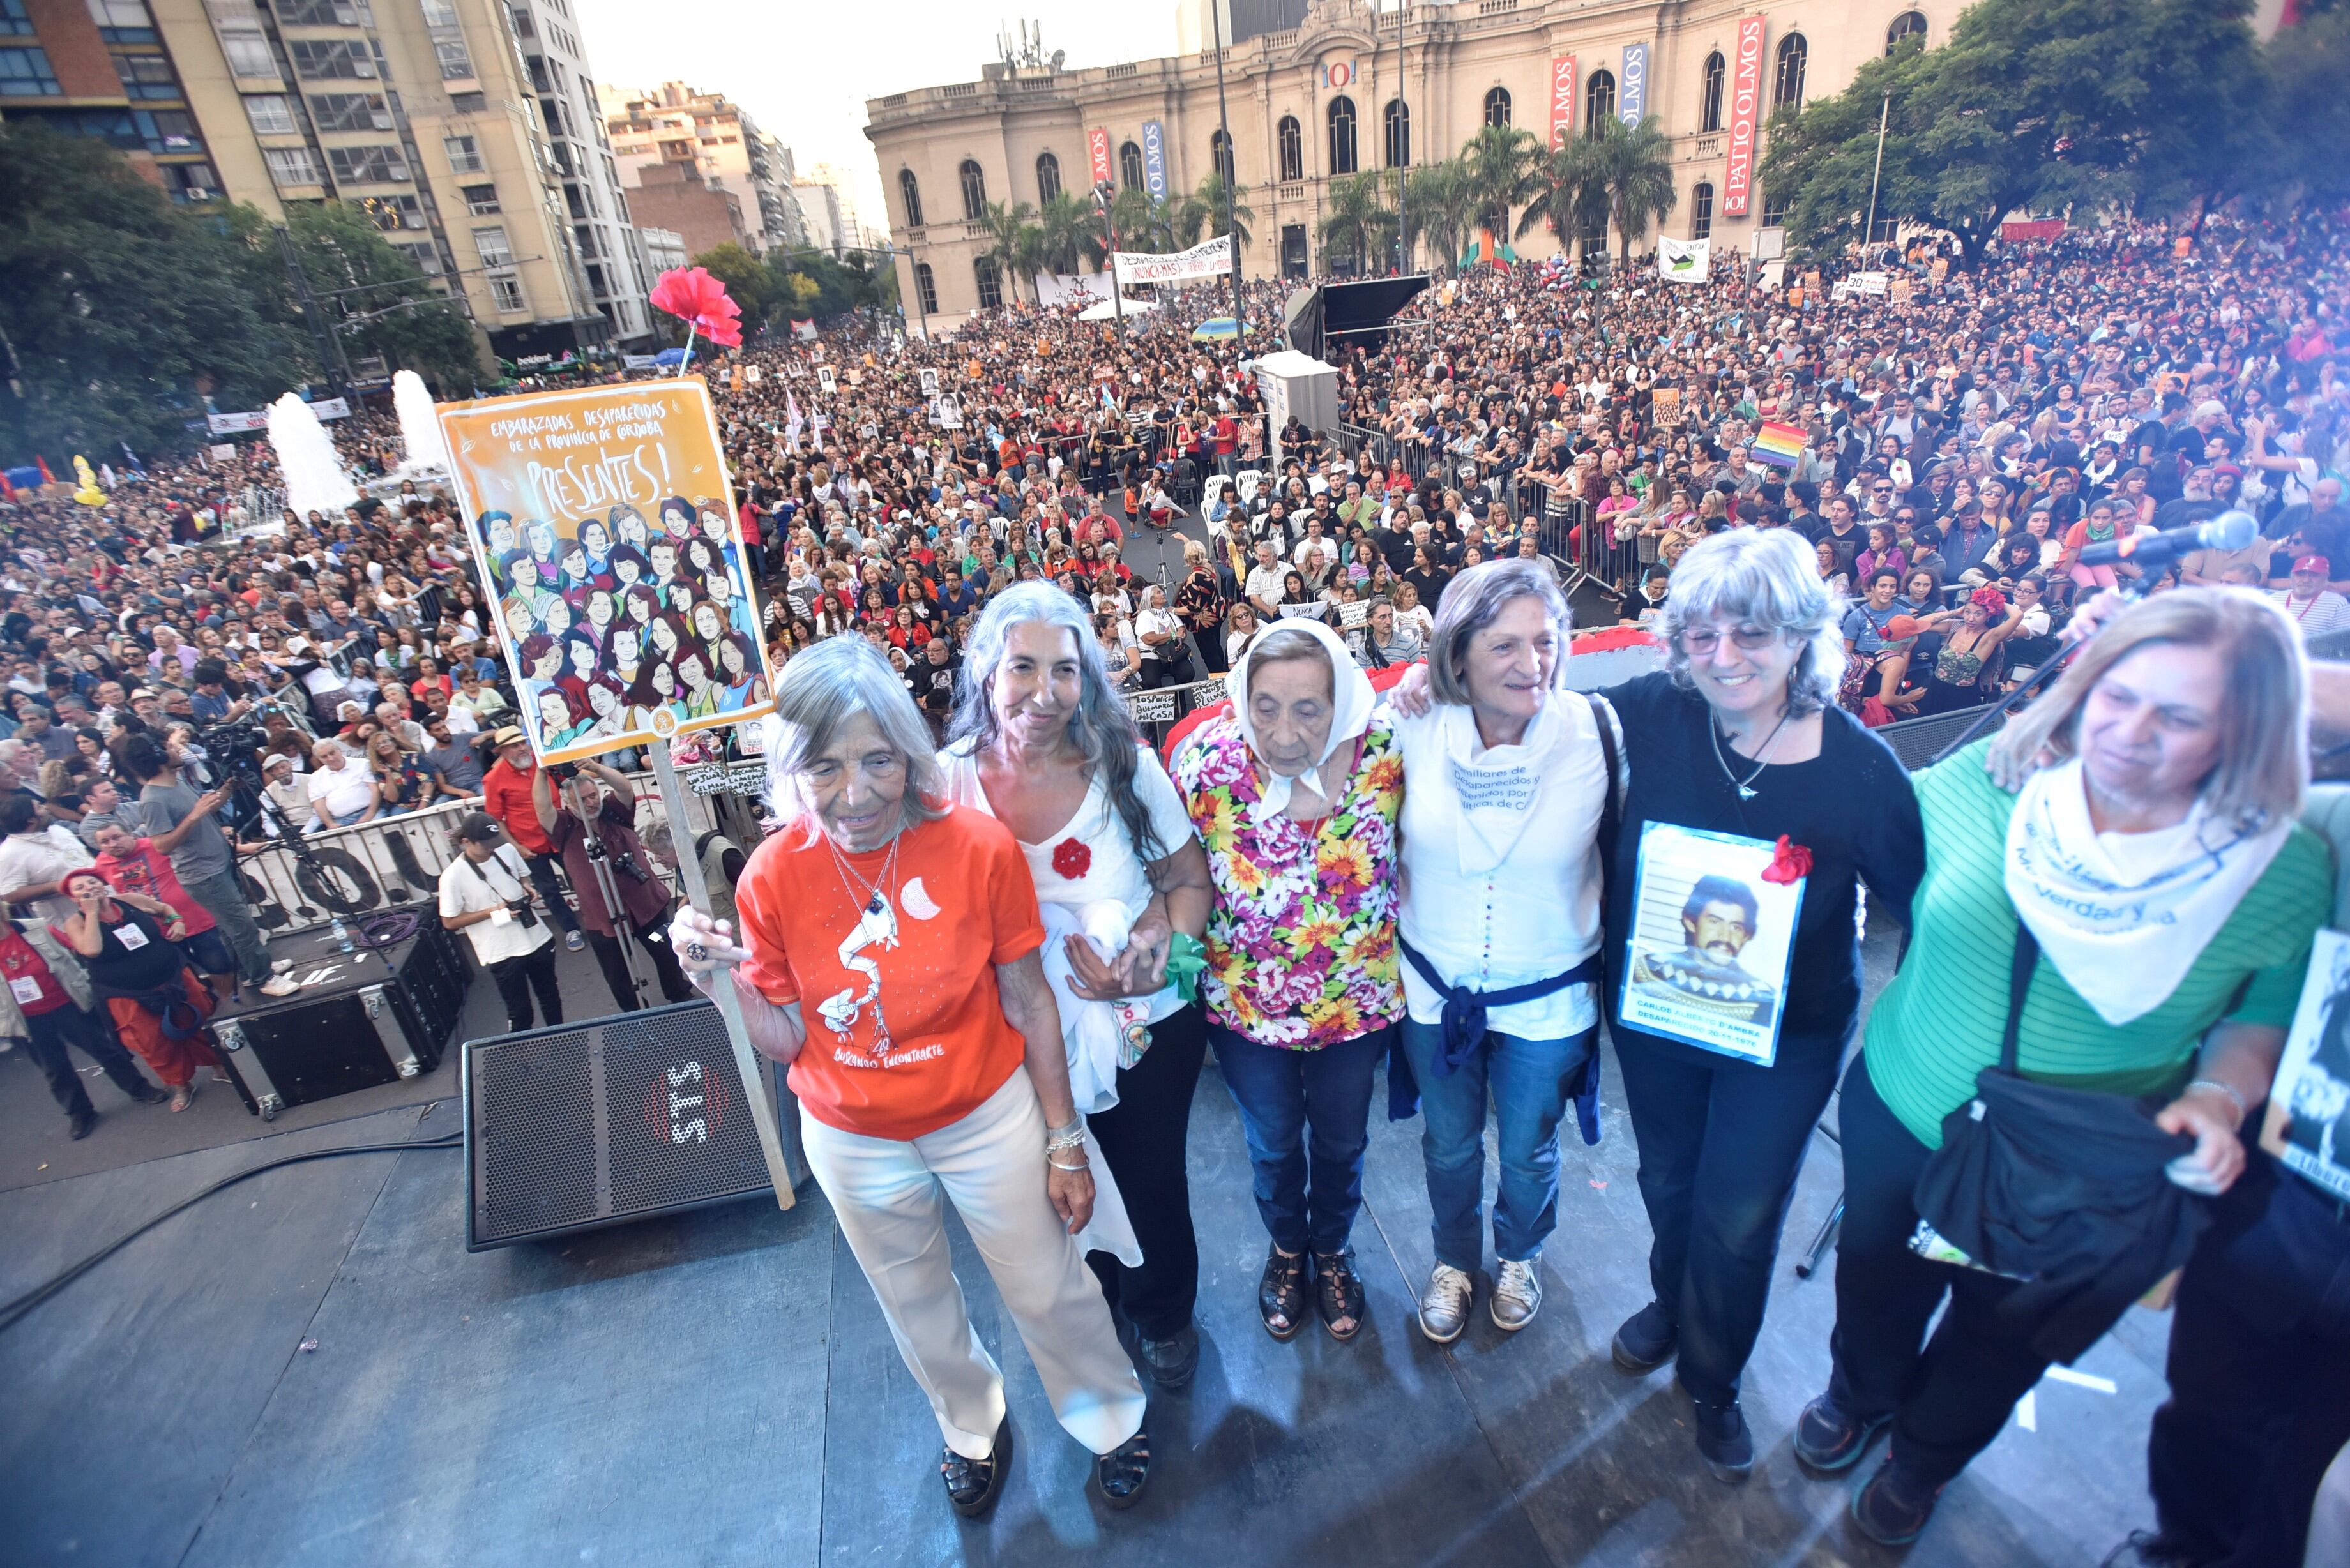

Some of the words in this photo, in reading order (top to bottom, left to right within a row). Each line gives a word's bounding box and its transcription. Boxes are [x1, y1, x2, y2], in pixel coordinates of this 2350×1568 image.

[1736, 20, 1760, 116] OLMOS
[1622, 47, 1643, 131] OLMOS
[1553, 61, 1572, 143] OLMOS
[1091, 132, 1109, 185] LMOS
[1144, 124, 1164, 192] OLMOS
[1729, 119, 1750, 192] PATIO
[1724, 195, 1745, 211] ¡O!
[517, 352, 553, 366] beldent
[490, 412, 574, 439] EMBARAZADAS
[583, 400, 666, 428] DESAPARECIDAS
[508, 441, 524, 453] DE
[528, 437, 542, 451] LA
[545, 429, 598, 449] PROVINCIA
[598, 428, 612, 441] DE
[1292, 606, 1314, 618] NUNCA
[691, 781, 726, 794] CELMAN
[1453, 770, 1531, 790] Desaparecidos
[1534, 775, 1541, 785] y
[1455, 781, 1505, 799] Detenidos
[1508, 789, 1529, 798] por
[1497, 799, 1513, 808] de
[1637, 1000, 1672, 1014] CARLOS
[1674, 1010, 1717, 1026] ALBERTO
[1719, 1021, 1761, 1038] D'AMBRA
[1637, 1010, 1705, 1034] DESAPARECIDO
[883, 1044, 945, 1069] ENCONTRARTE
[667, 1061, 707, 1144] STS
